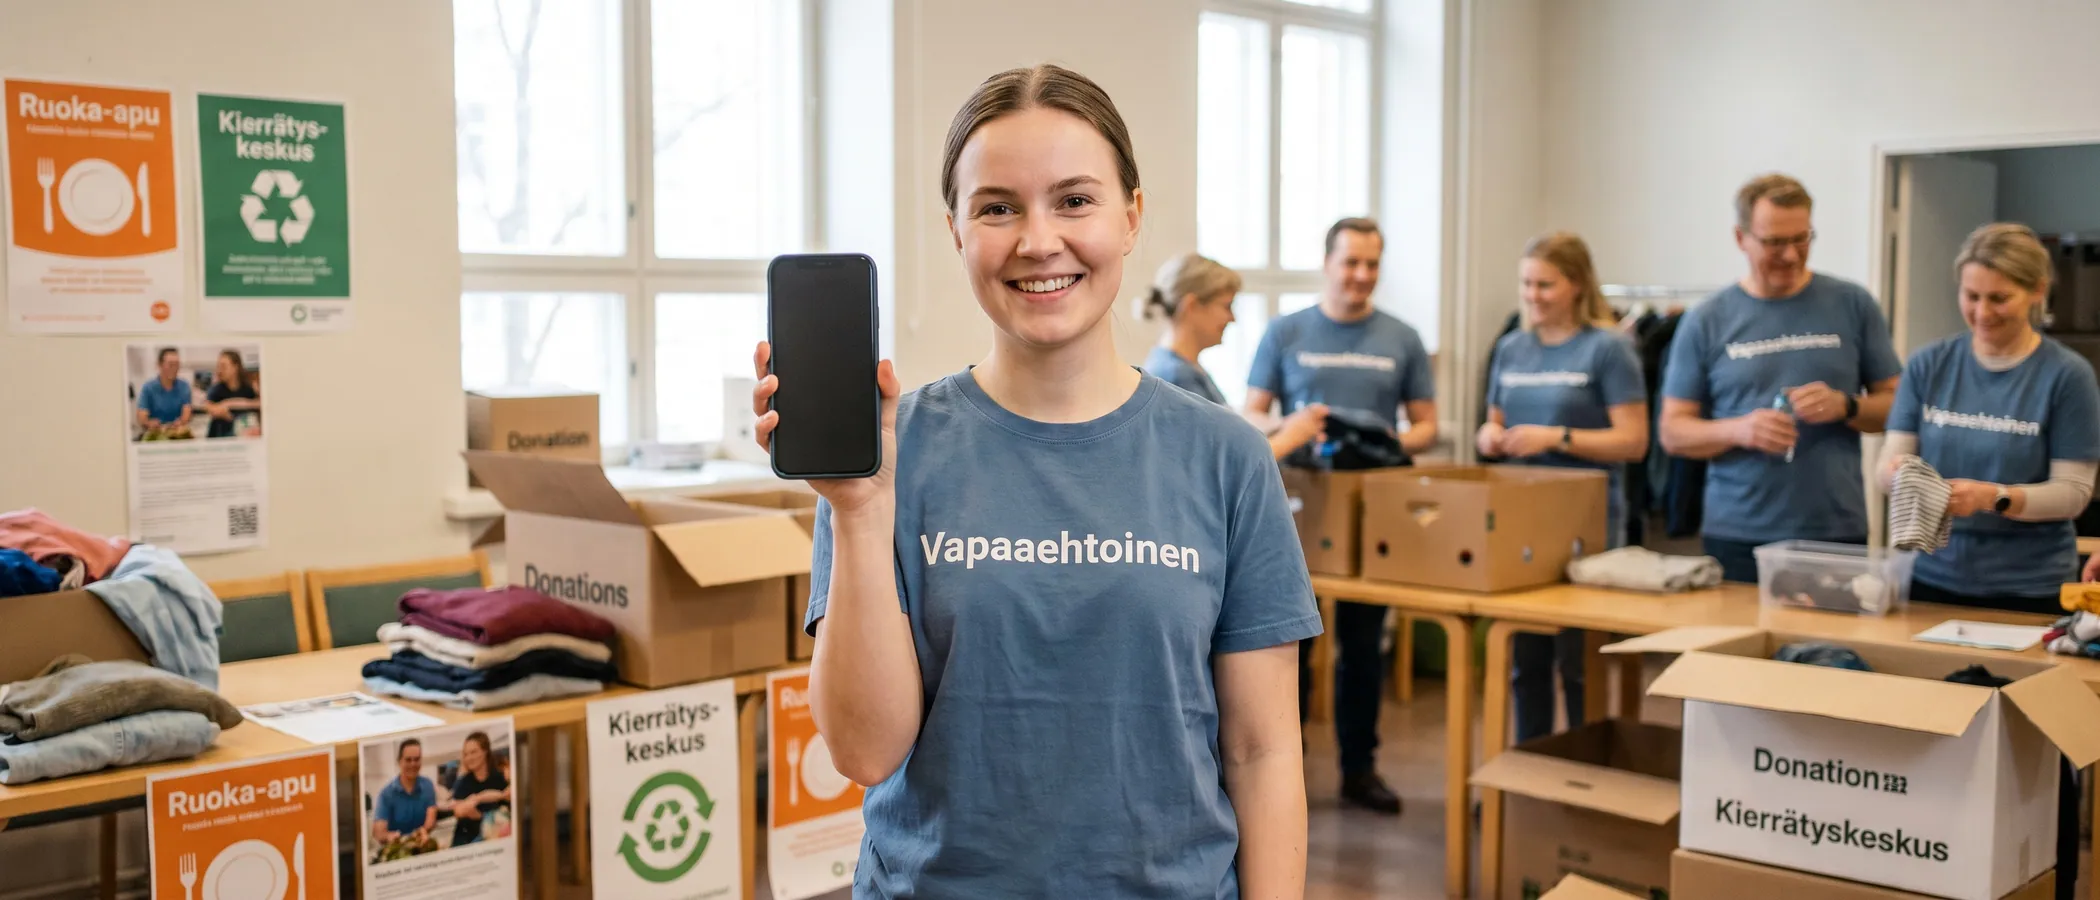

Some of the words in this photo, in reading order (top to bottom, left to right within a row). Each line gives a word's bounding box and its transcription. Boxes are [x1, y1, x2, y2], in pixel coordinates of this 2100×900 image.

[18, 91, 160, 131] Ruoka-apu
[218, 109, 328, 141] Kierrätys-
[236, 136, 315, 162] keskus
[507, 429, 589, 450] Donation
[920, 530, 1200, 573] Vapaaehtoinen
[525, 563, 629, 609] Donations
[608, 702, 719, 737] Kierrätys-
[625, 732, 706, 764] keskus
[168, 772, 317, 818] Ruoka-apu
[1715, 797, 1950, 862] Kierrätyskeskus
